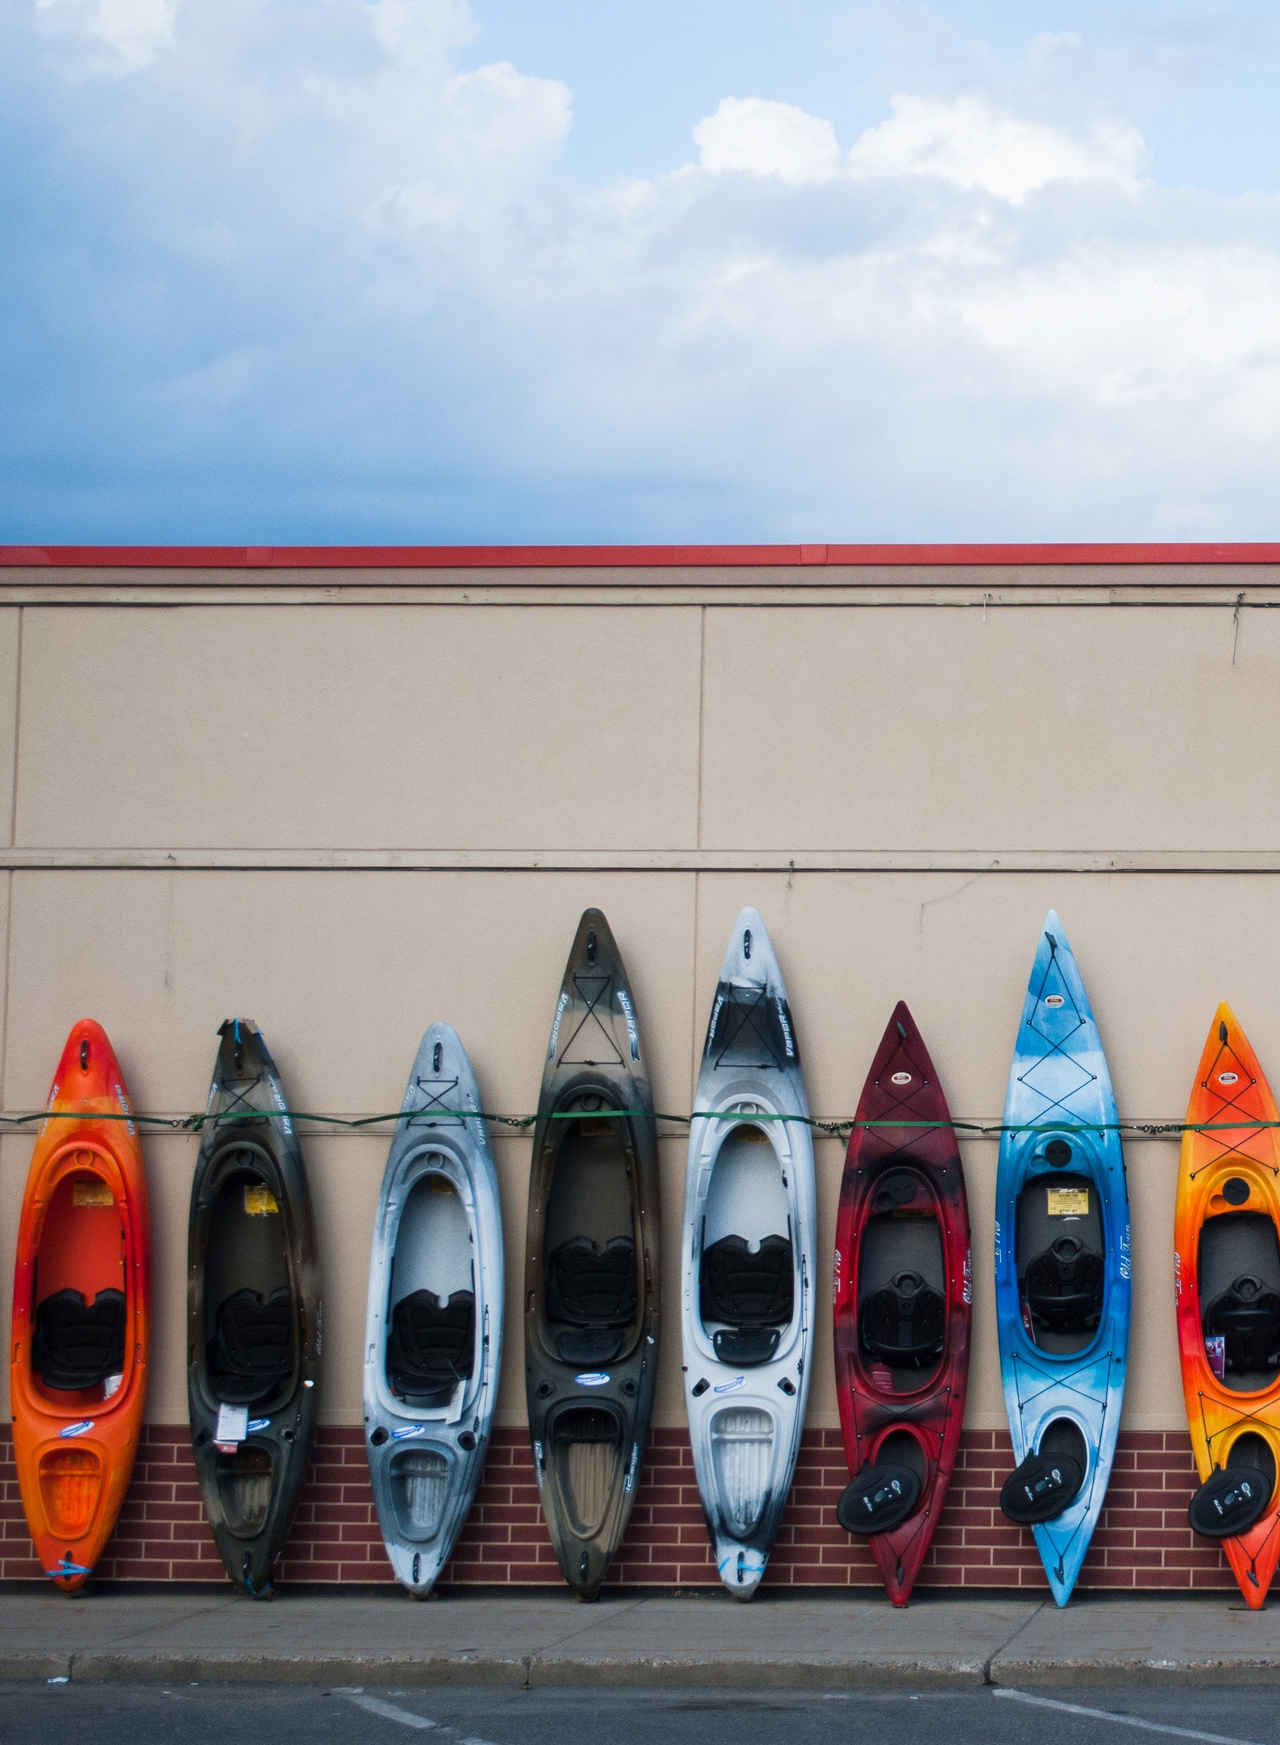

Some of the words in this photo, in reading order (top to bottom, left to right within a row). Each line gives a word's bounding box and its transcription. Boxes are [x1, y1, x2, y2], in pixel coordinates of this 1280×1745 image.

[617, 990, 637, 1039] VAPOR
[779, 1014, 795, 1057] VAPOR
[1120, 1224, 1131, 1254] Town
[963, 1249, 973, 1281] Town
[1120, 1255, 1131, 1279] Old
[963, 1280, 973, 1304] Old
